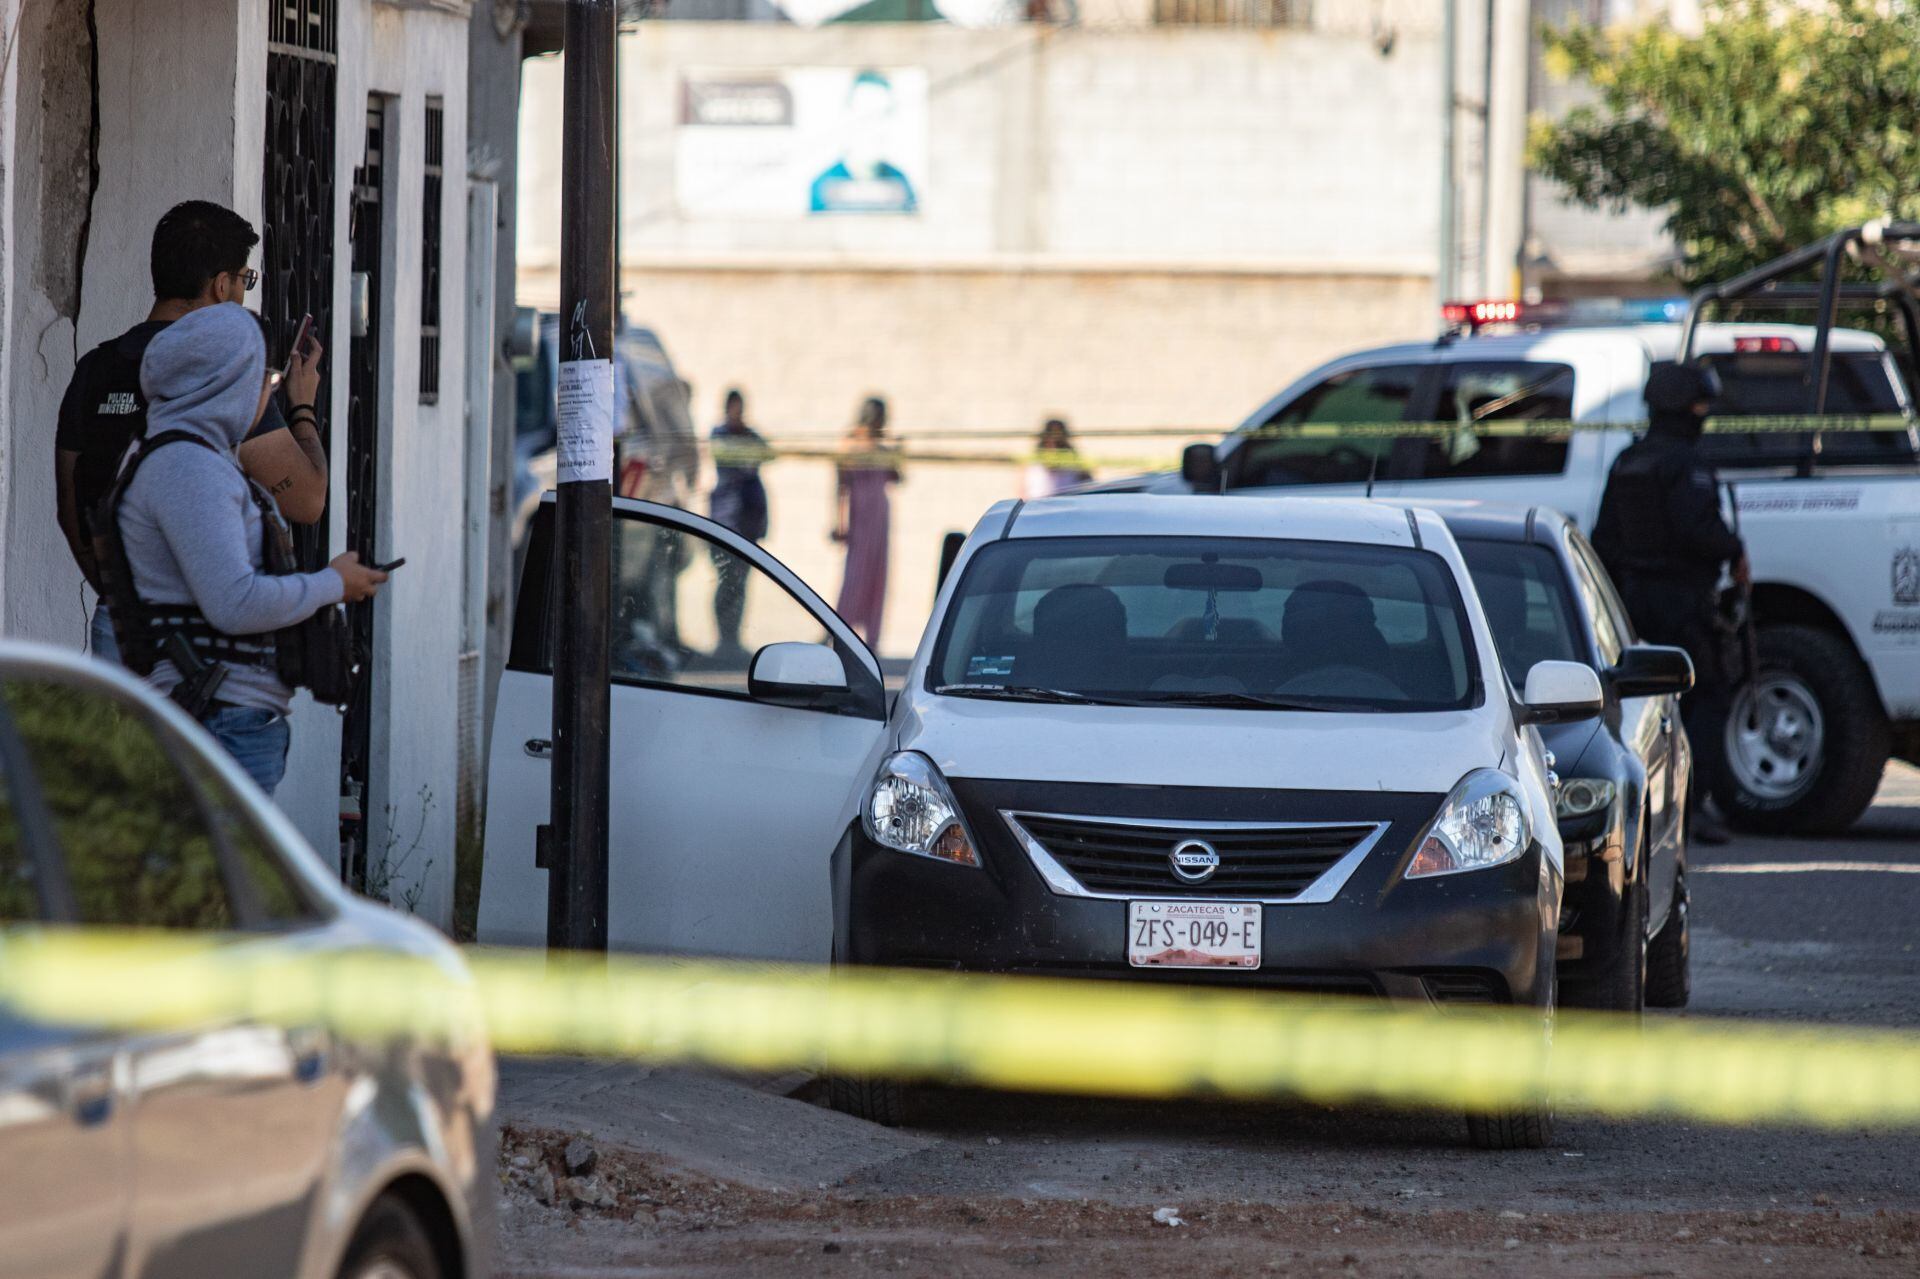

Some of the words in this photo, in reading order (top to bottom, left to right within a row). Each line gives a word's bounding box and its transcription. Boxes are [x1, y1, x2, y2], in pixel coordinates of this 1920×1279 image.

[107, 392, 135, 404] POLICIA
[1173, 855, 1214, 864] NISSAN
[1167, 905, 1225, 915] ZACATECAS
[1135, 919, 1255, 949] ZFS-049-E
